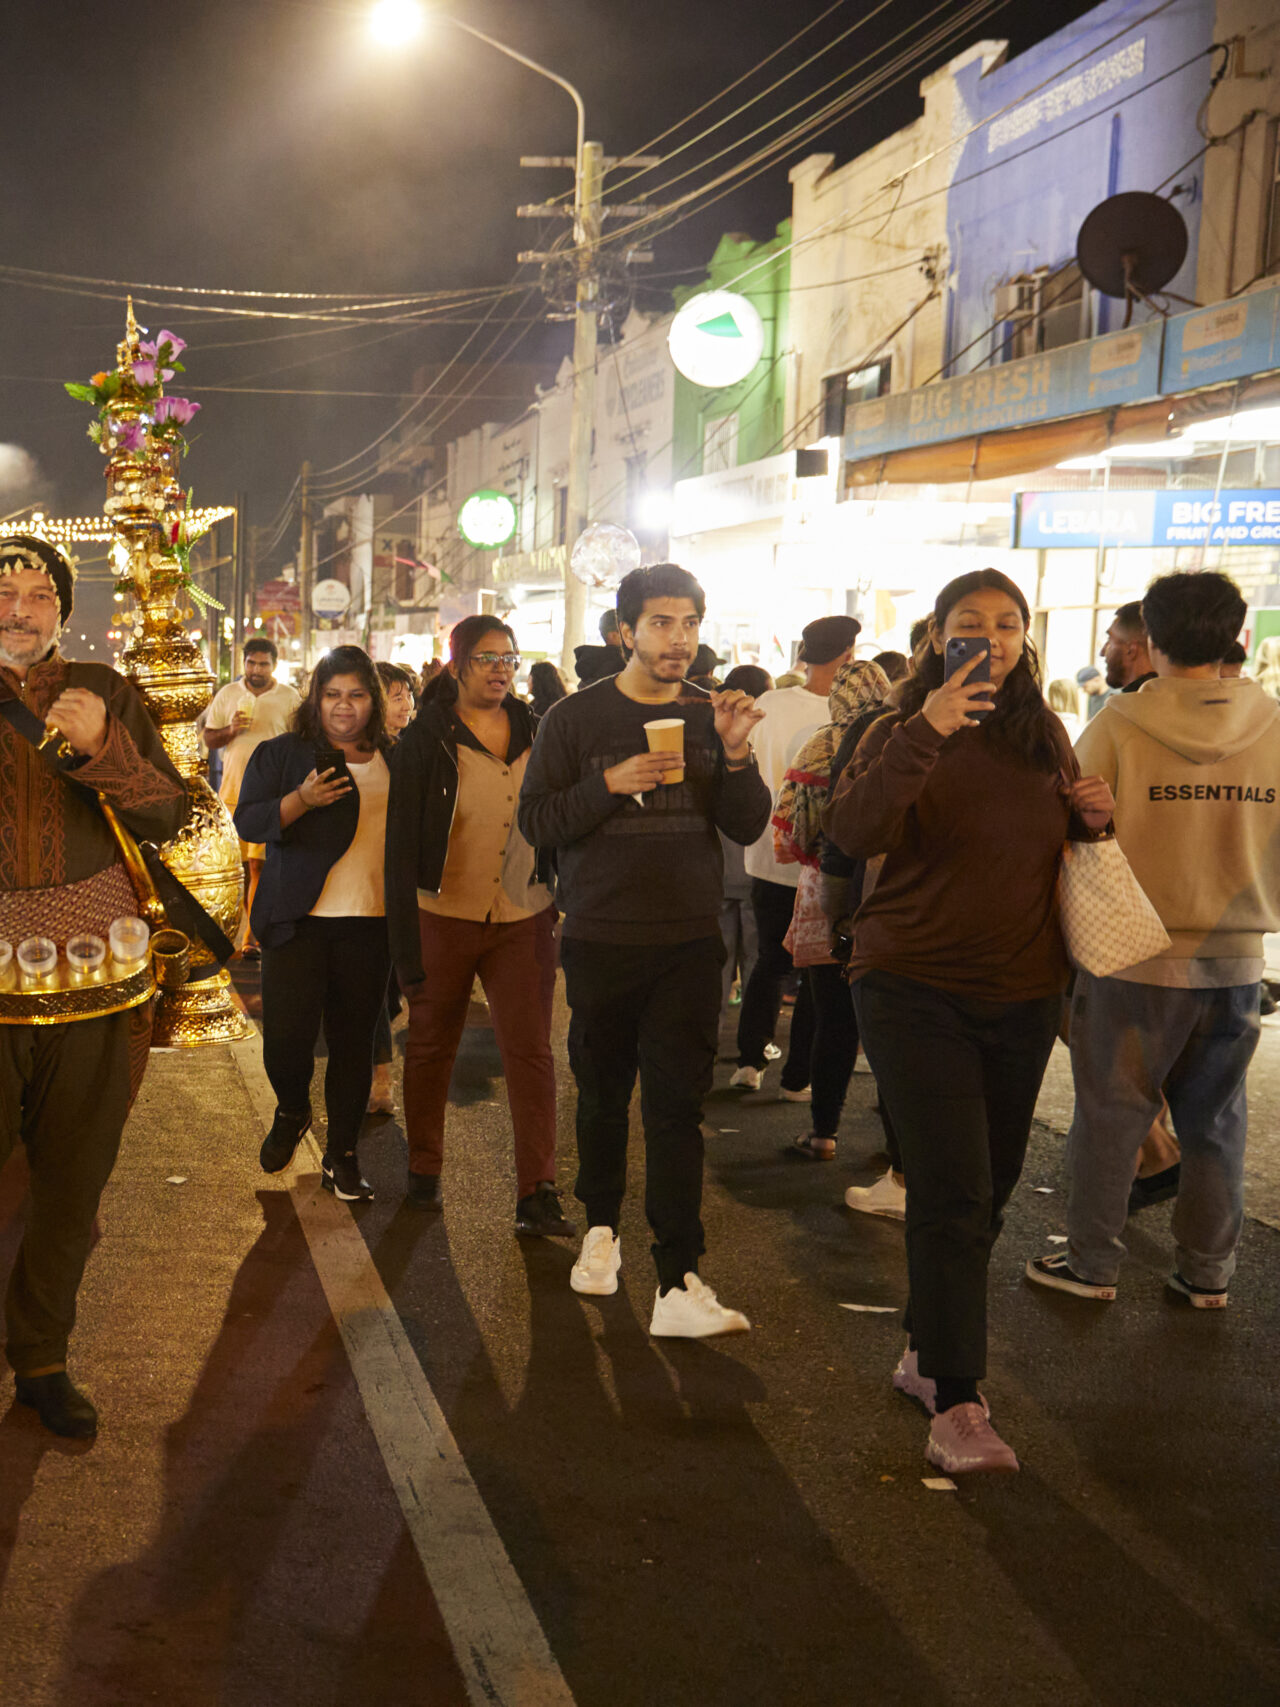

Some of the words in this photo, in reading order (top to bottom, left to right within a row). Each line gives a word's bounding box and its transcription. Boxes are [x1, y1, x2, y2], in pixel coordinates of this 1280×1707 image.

[909, 385, 952, 425] BIG
[960, 360, 1051, 414] FRESH
[1037, 509, 1138, 535] LEBARA
[1171, 501, 1222, 525] BIG
[1228, 500, 1280, 523] FRE
[1166, 526, 1208, 541] FRUIT
[1212, 526, 1249, 540] AND
[1149, 784, 1276, 803] ESSENTIALS
